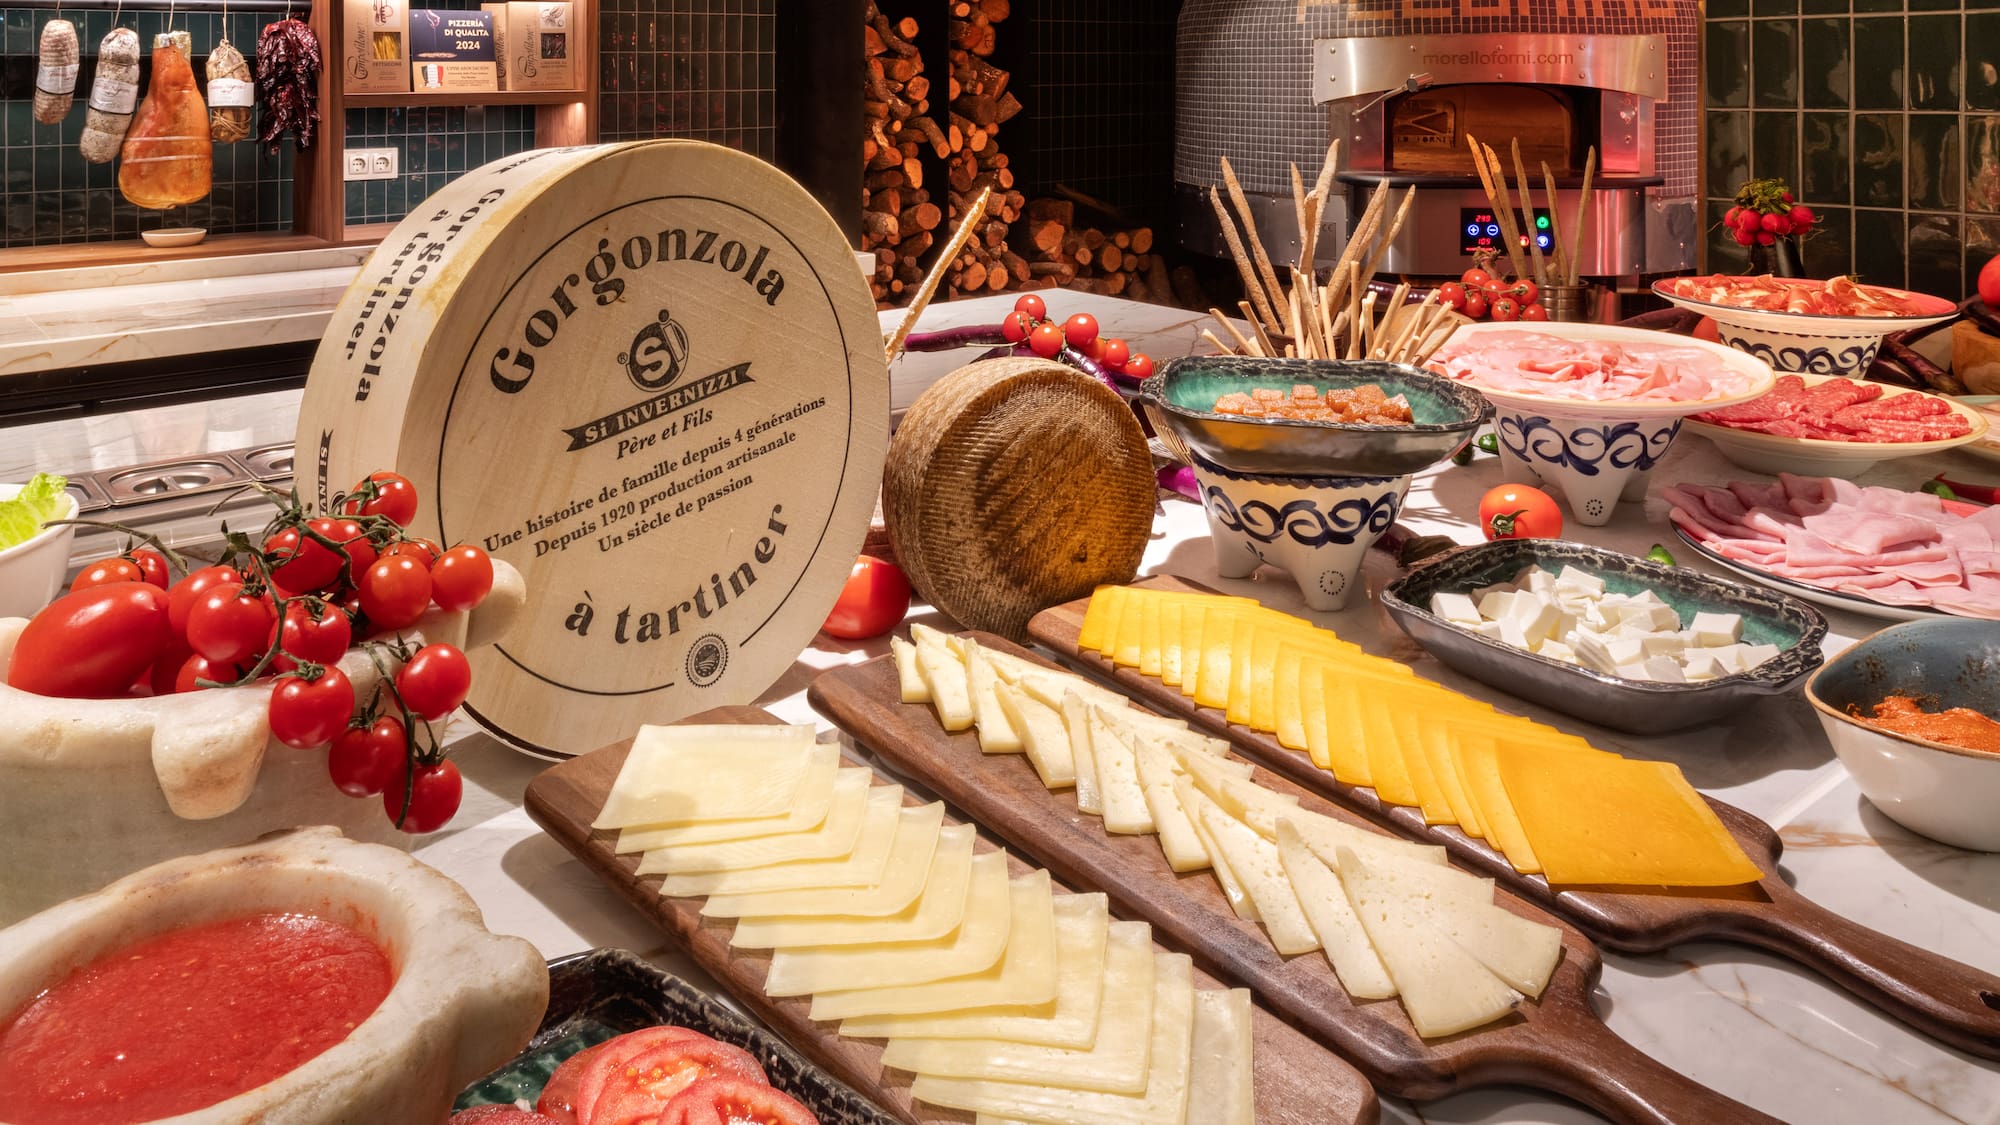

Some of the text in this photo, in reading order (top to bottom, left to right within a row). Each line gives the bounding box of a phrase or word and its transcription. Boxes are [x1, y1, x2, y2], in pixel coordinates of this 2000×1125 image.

[455, 29, 489, 37] QUALITA
[456, 41, 480, 50] 2024
[1423, 51, 1574, 65] morelloforni.com
[345, 231, 429, 360] tartiner
[355, 188, 505, 403] Gorgonzola
[490, 228, 785, 395] Gorgonzola
[585, 371, 738, 443] Si INVERNIZZI
[617, 408, 713, 460] Père et Fils
[483, 396, 826, 553] Une histoire de famille depuis 4 générations
[534, 432, 797, 559] Depuis 1920 production artisanale
[598, 474, 754, 553] Un siècle de passion
[565, 503, 788, 645] à tartiner
